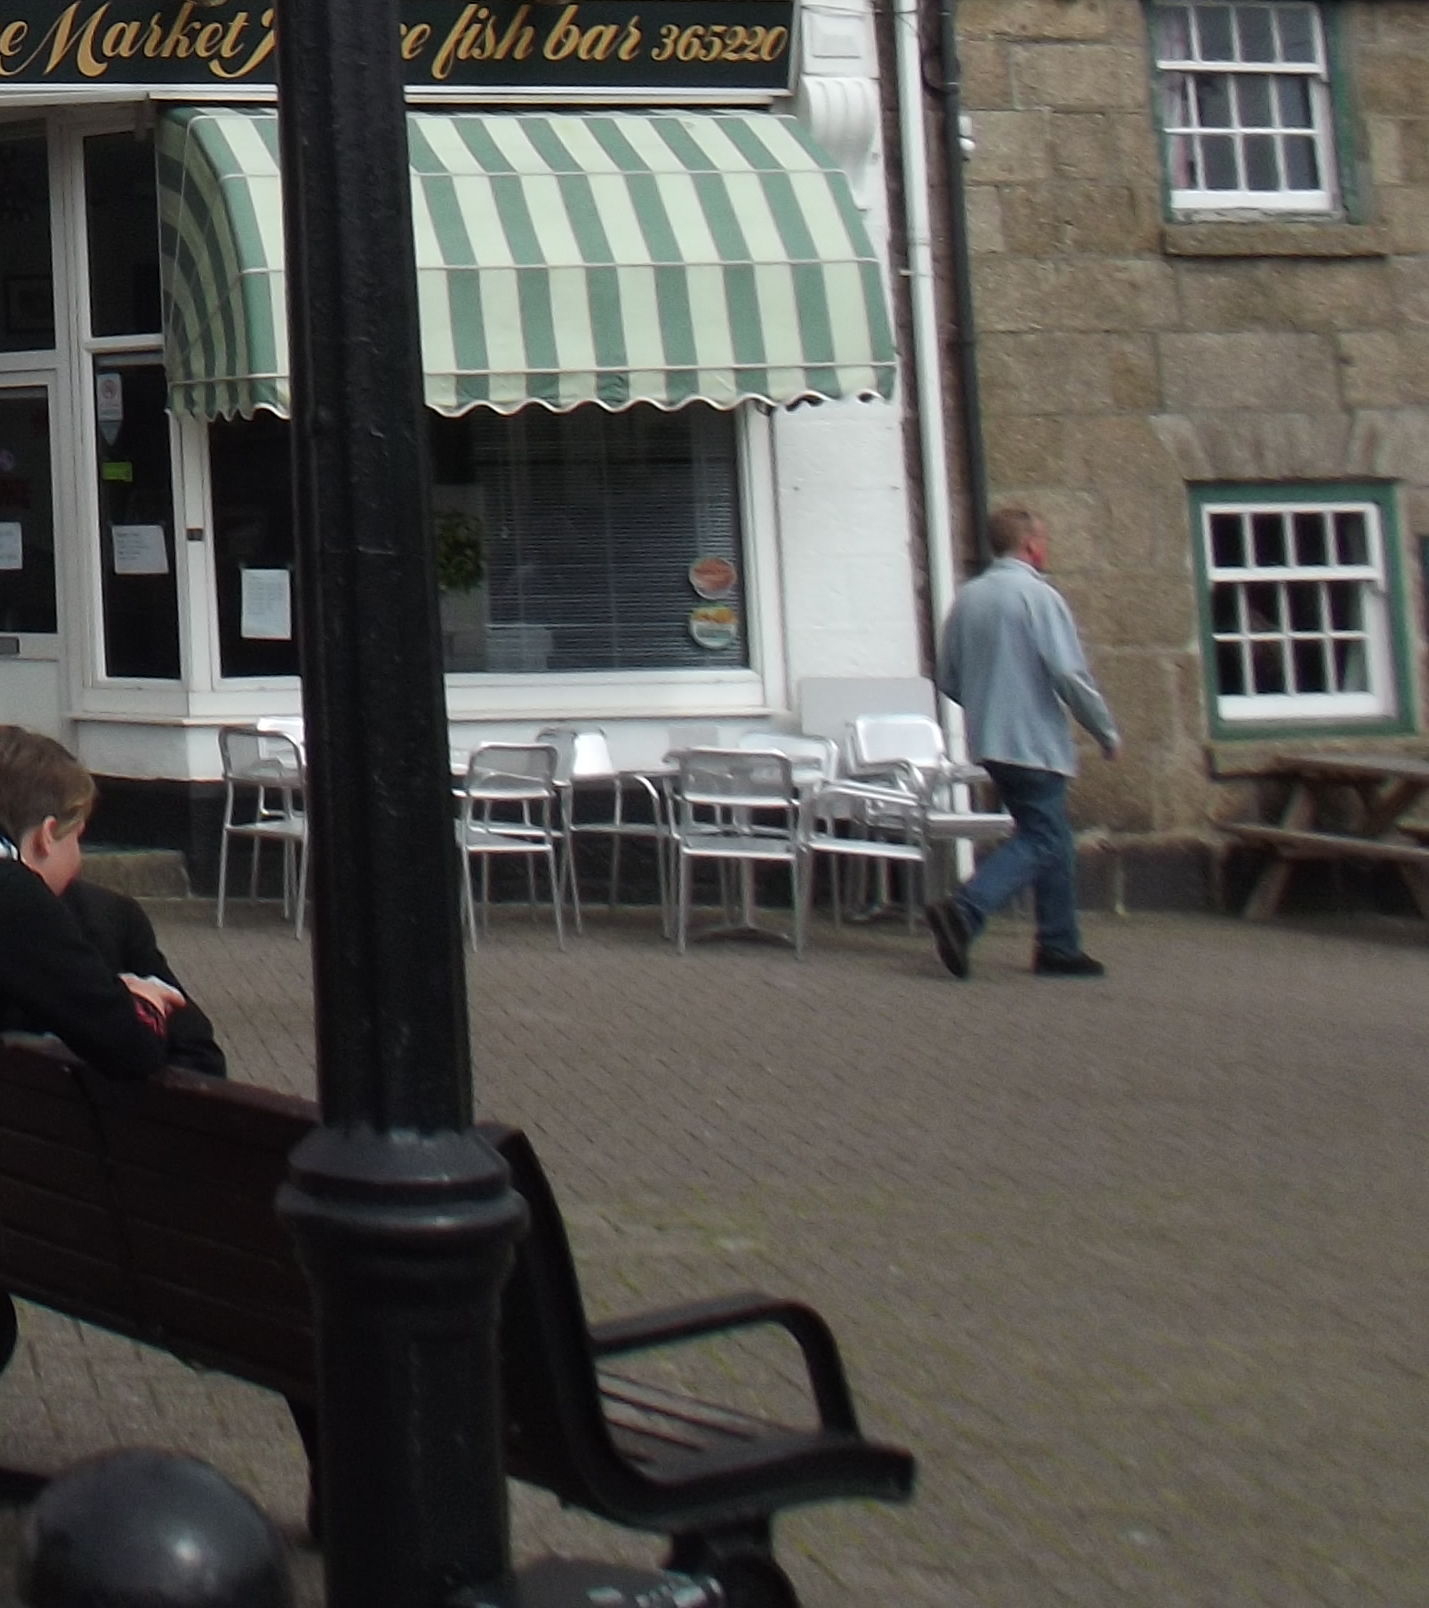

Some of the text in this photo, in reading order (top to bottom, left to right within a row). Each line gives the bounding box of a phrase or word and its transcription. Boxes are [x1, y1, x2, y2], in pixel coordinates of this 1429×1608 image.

[431, 3, 535, 80] fish
[543, 4, 641, 62] bar
[650, 23, 788, 63] 365220
